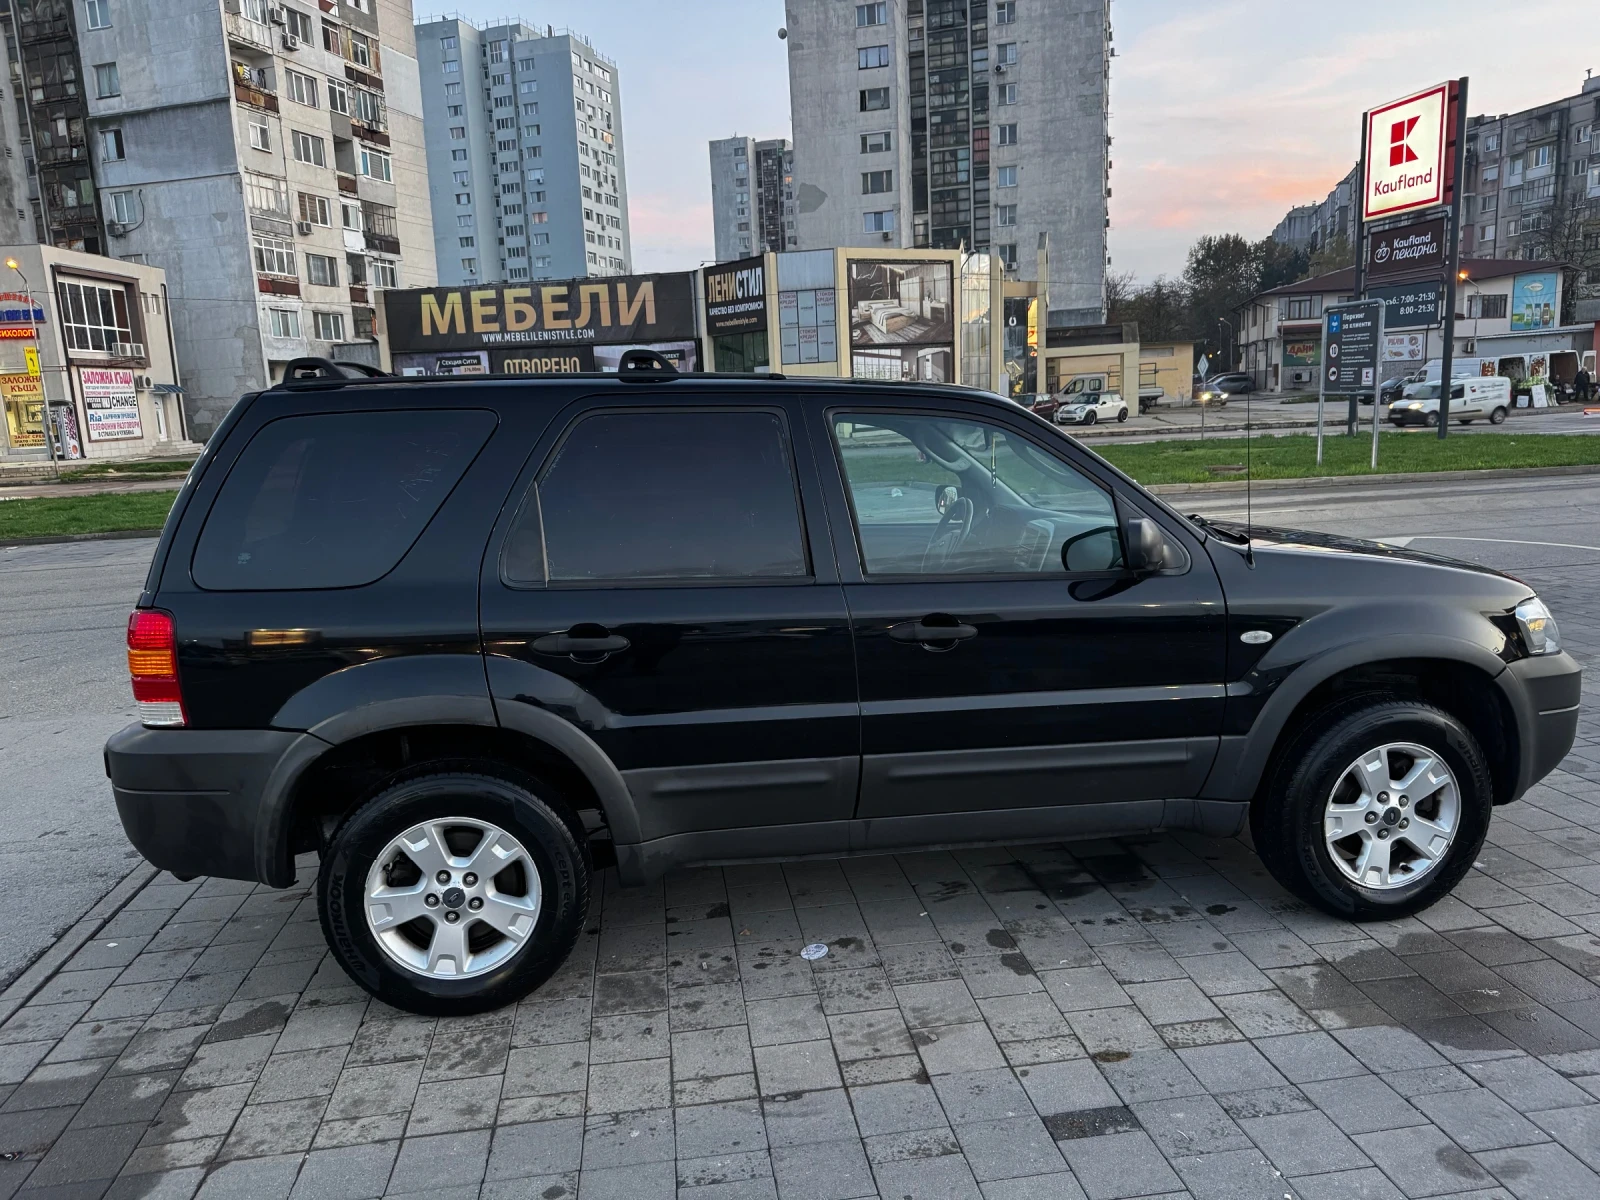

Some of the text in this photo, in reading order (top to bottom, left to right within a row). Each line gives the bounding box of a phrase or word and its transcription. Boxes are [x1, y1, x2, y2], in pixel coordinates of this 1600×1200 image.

[1374, 167, 1433, 197] Kaufland
[1393, 231, 1431, 249] Kaufland
[708, 266, 763, 303] ЛЕНИСТИЛ
[421, 281, 656, 336] МЕБЕЛИ
[481, 328, 596, 344] WWW.MEBELILENISTYLE.COM
[503, 356, 581, 373] ОТВОРЕНО
[82, 371, 133, 386] ЗАЛОЖНА КЪЩА
[111, 395, 137, 408] CHANGE
[89, 411, 103, 422] Ria
